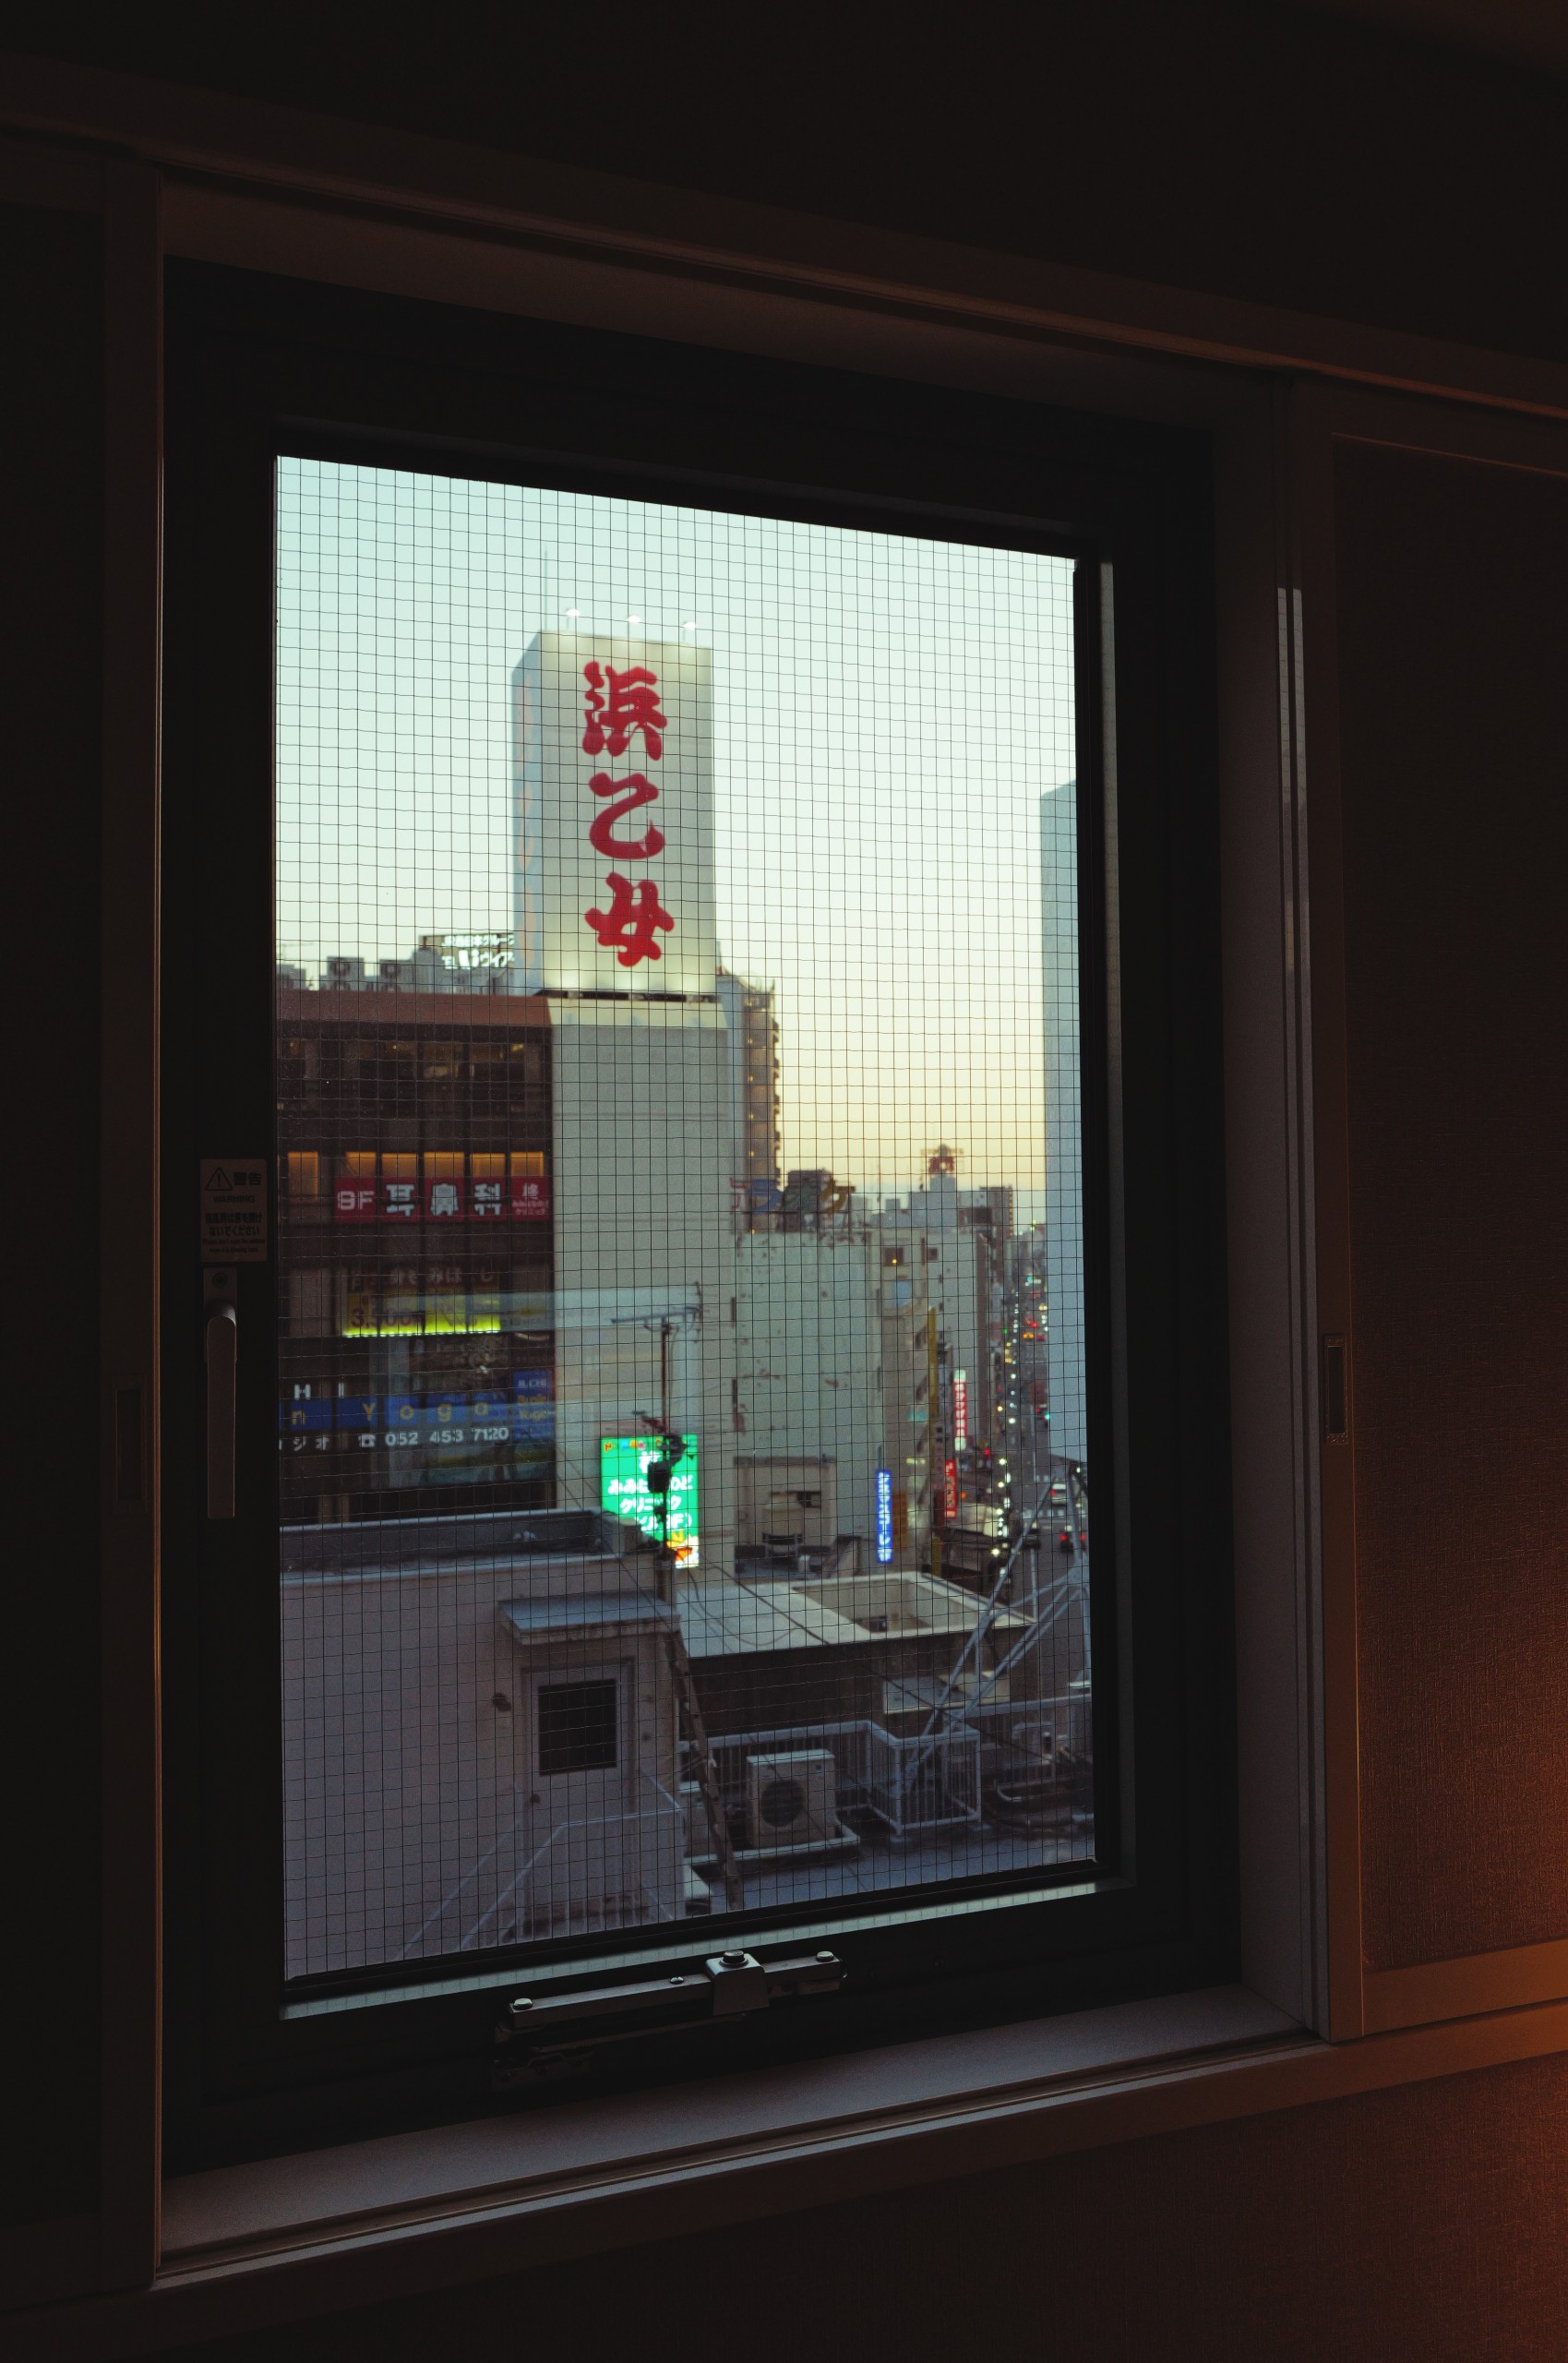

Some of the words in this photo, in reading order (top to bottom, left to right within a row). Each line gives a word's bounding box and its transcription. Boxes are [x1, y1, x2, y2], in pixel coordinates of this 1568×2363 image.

[581, 660, 676, 967] 浜乙女
[386, 1182, 502, 1217] 耳鼻科
[384, 1432, 419, 1447] 052
[428, 1429, 465, 1445] 453
[472, 1426, 510, 1442] 7120
[607, 1474, 694, 1495] みみはのど
